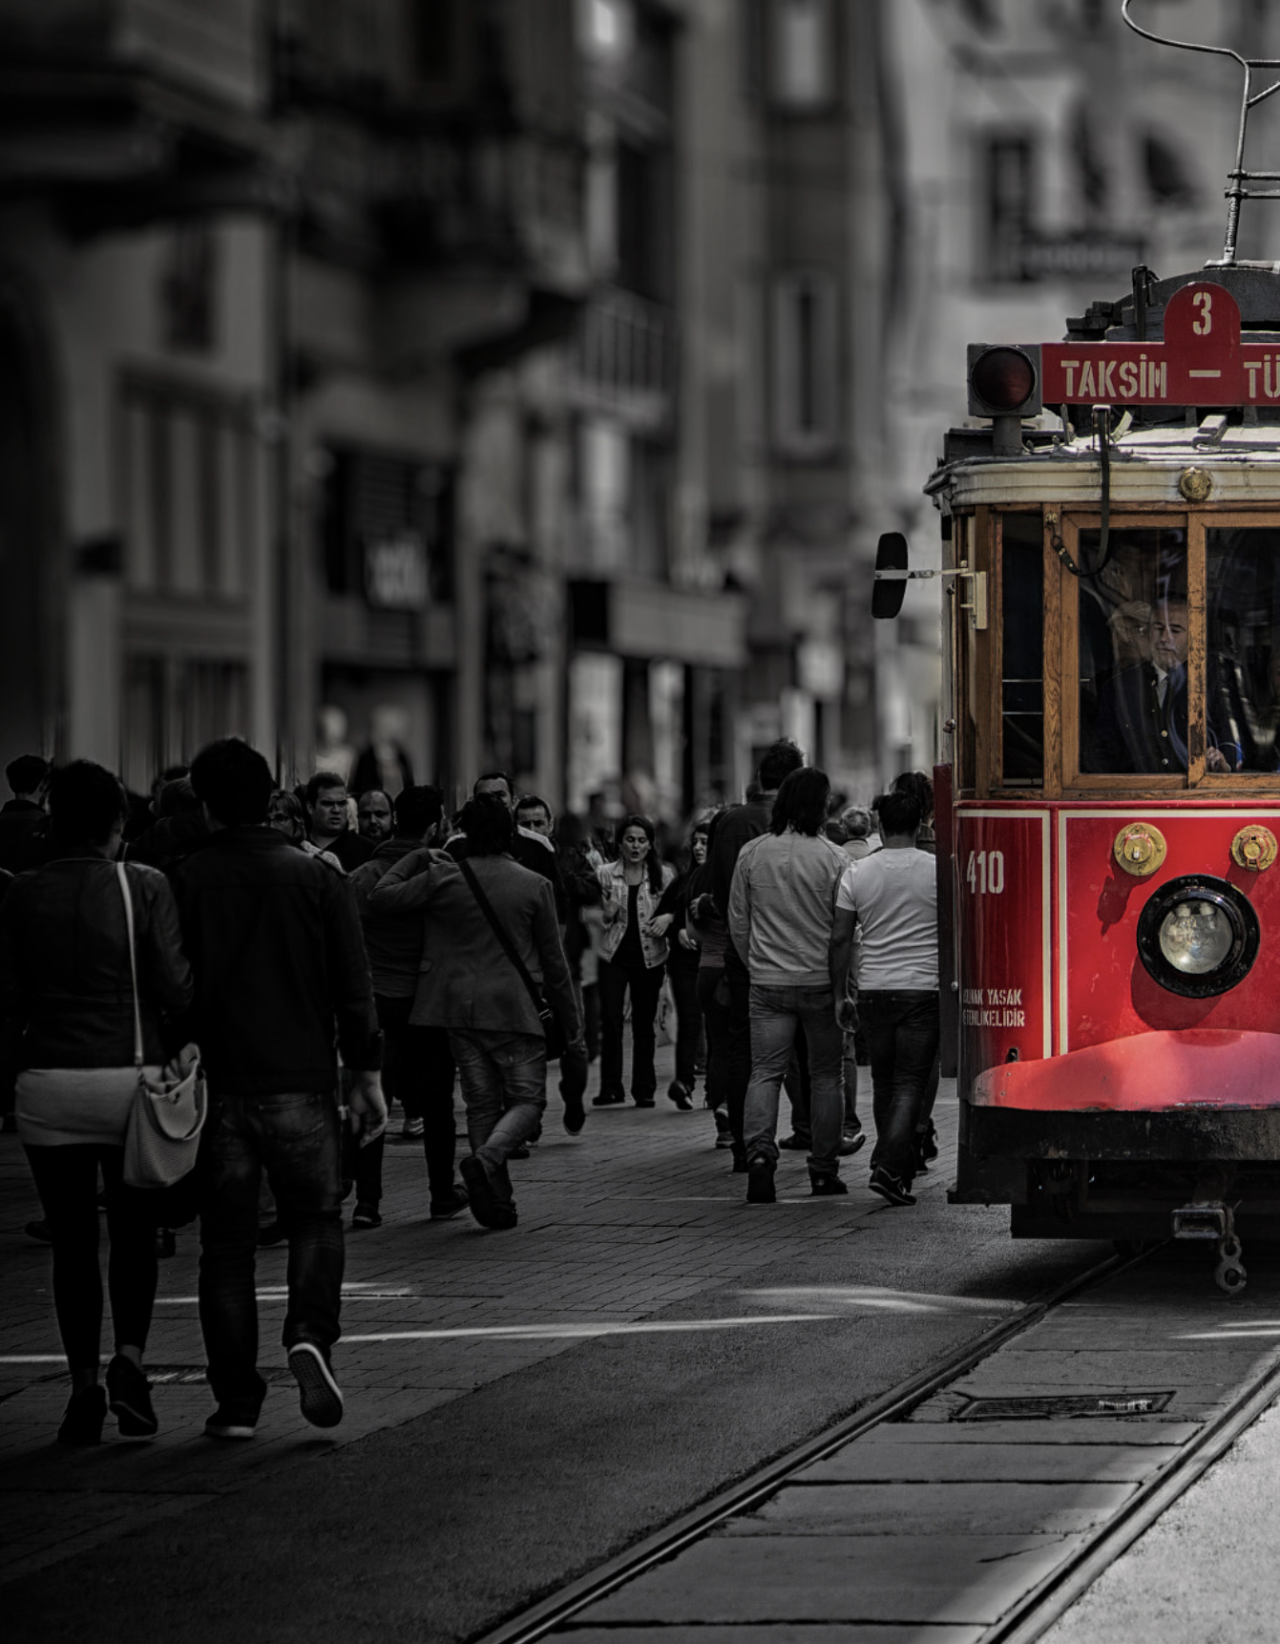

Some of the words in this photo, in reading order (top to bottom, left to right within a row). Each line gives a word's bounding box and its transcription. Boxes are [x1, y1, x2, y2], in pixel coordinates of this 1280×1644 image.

[1192, 291, 1212, 335] 3
[1060, 353, 1168, 399] TAKSİM
[966, 850, 1005, 894] 410
[986, 988, 1022, 1006] YASAK
